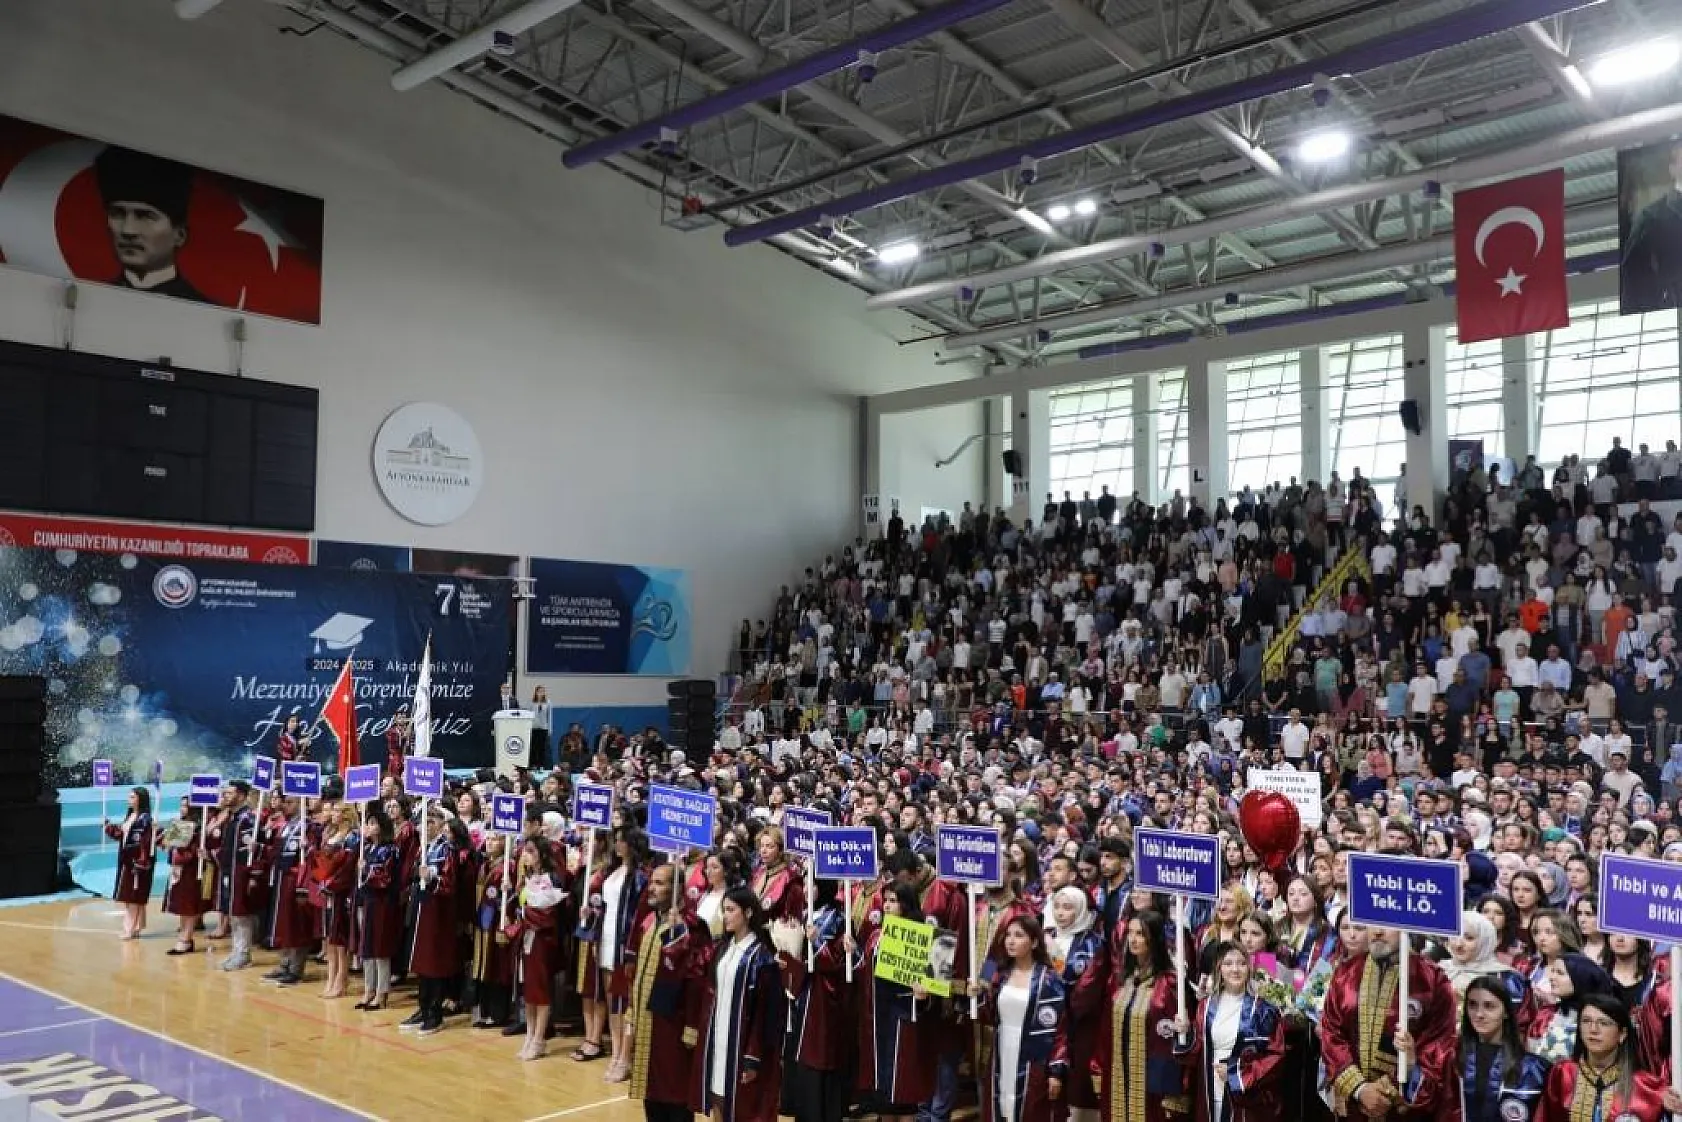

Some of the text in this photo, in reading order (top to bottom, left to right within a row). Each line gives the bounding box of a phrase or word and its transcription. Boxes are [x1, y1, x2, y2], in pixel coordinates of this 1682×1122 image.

[33, 530, 118, 550] CUMHURİYETİN
[435, 584, 455, 616] 7
[313, 658, 339, 671] 2024
[1142, 838, 1162, 857] Tıbbi
[1364, 872, 1443, 895] Tıbbi Lab.
[1611, 874, 1647, 896] Tıbbi
[1652, 883, 1669, 899] ve
[1370, 892, 1436, 914] Tek. İ.Ö.
